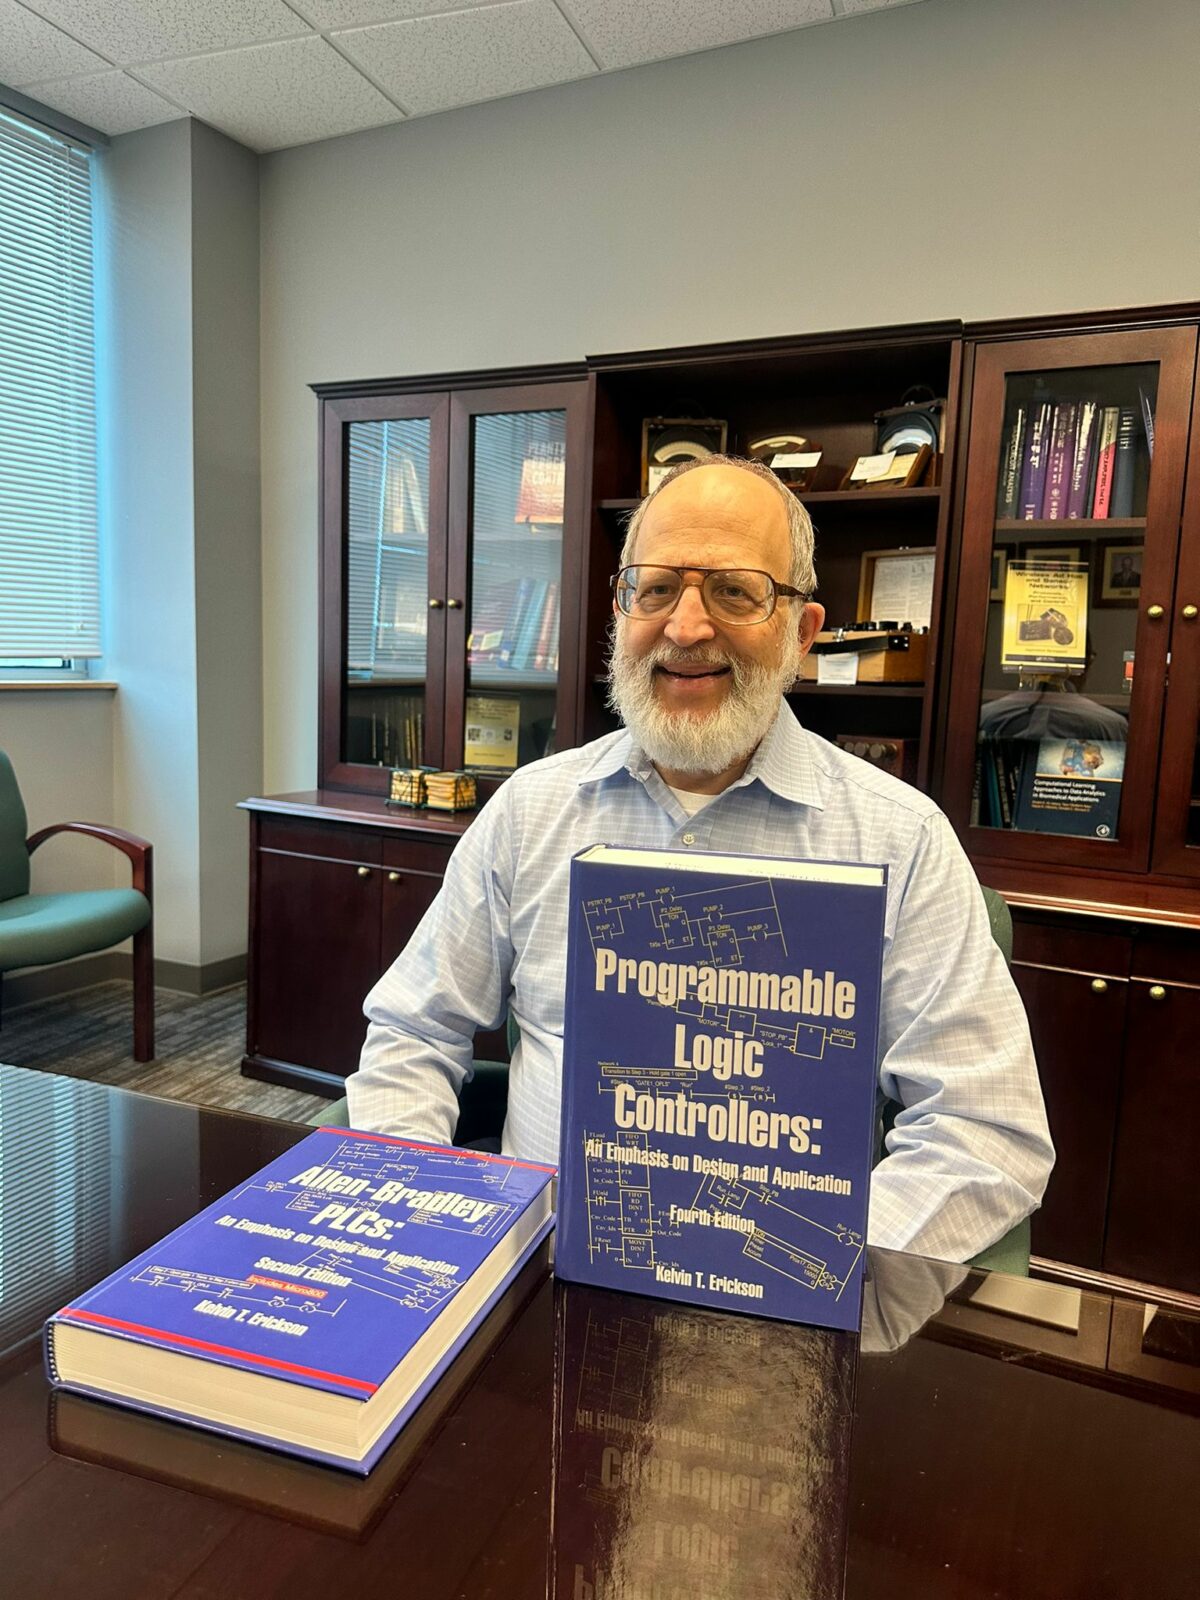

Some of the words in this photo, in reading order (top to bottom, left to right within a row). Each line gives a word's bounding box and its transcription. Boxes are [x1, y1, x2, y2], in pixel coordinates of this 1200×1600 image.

[1006, 472, 1015, 503] ANALYSIS
[1034, 779, 1071, 788] Computational
[1072, 782, 1096, 790] Learning
[1068, 795, 1099, 803] Applications
[1082, 789, 1106, 797] Analytics
[595, 947, 856, 1020] Programmable
[674, 1023, 764, 1081] Logic
[614, 1083, 822, 1156] Controllers:
[585, 1139, 603, 1158] An
[606, 1141, 669, 1169] Emphasis
[672, 1154, 689, 1172] on
[692, 1155, 738, 1180] Design
[742, 1165, 768, 1184] and
[772, 1166, 851, 1196] Application
[288, 1166, 496, 1223] Allen-Bradley
[309, 1203, 405, 1240] PLCs:
[669, 1204, 712, 1228] Fourth
[713, 1209, 756, 1234] Edition
[214, 1214, 232, 1227] An
[233, 1218, 296, 1240] Emphasis
[293, 1230, 314, 1244] on
[311, 1235, 358, 1254] Design
[357, 1245, 387, 1260] and
[381, 1251, 460, 1276] Application
[247, 1275, 286, 1290] Includes
[254, 1256, 306, 1277] Second
[303, 1267, 352, 1288] Edition
[655, 1265, 692, 1288] Kelvin
[695, 1271, 705, 1289] T.
[709, 1274, 764, 1299] Erickson
[193, 1299, 237, 1319] Kelvin
[234, 1310, 250, 1322] T.
[247, 1312, 309, 1337] Erickson
